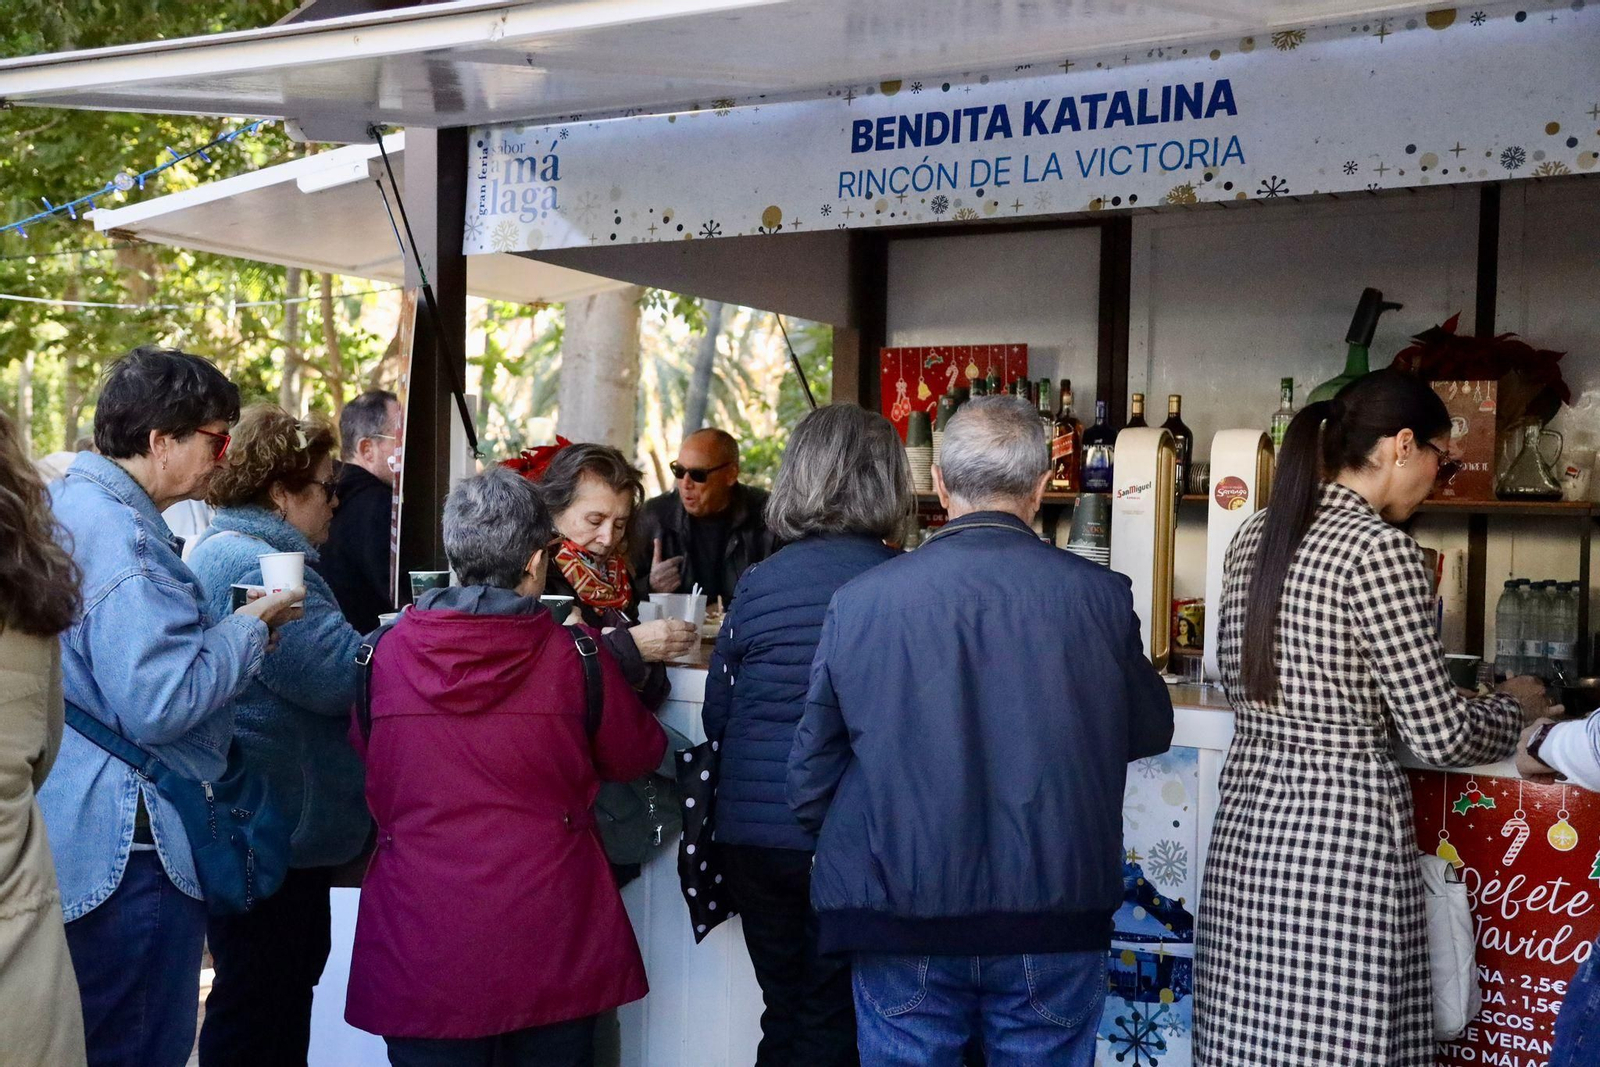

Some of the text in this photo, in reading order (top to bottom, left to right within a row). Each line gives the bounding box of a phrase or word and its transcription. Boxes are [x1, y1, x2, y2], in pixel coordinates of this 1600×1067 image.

[851, 79, 1238, 153] BENDITA KATALINA
[478, 147, 488, 216] gran feria
[838, 135, 1246, 198] RINCÓN DE LA VICTORIA
[1477, 964, 1567, 995] ÑA 2,5€
[1481, 990, 1506, 1006] UA
[1436, 1042, 1476, 1061] NTO
[1485, 1030, 1553, 1055] VERAN
